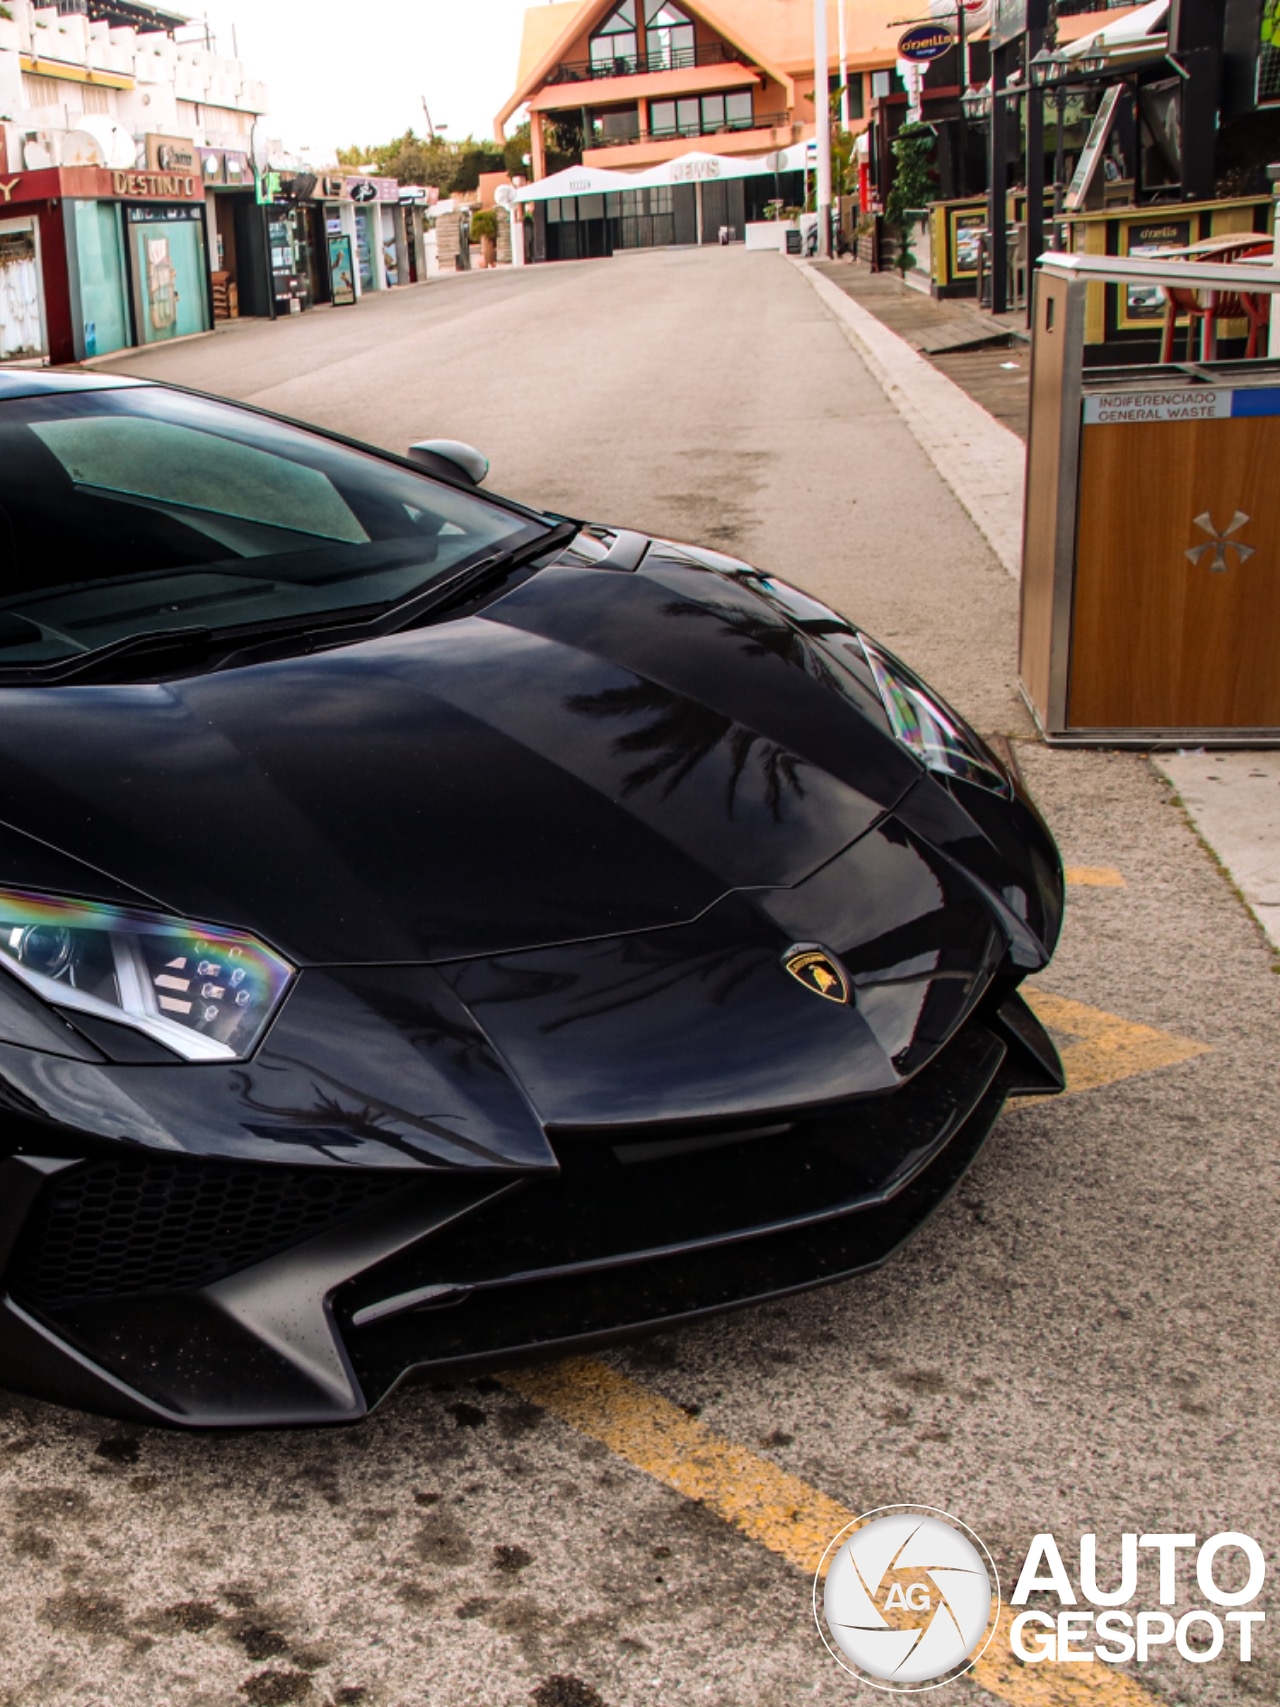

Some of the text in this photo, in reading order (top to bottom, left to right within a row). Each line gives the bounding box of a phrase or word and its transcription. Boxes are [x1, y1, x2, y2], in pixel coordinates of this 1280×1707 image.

[1099, 392, 1217, 408] INDIFERENCIADO
[1099, 406, 1217, 422] GENERAL WASTE
